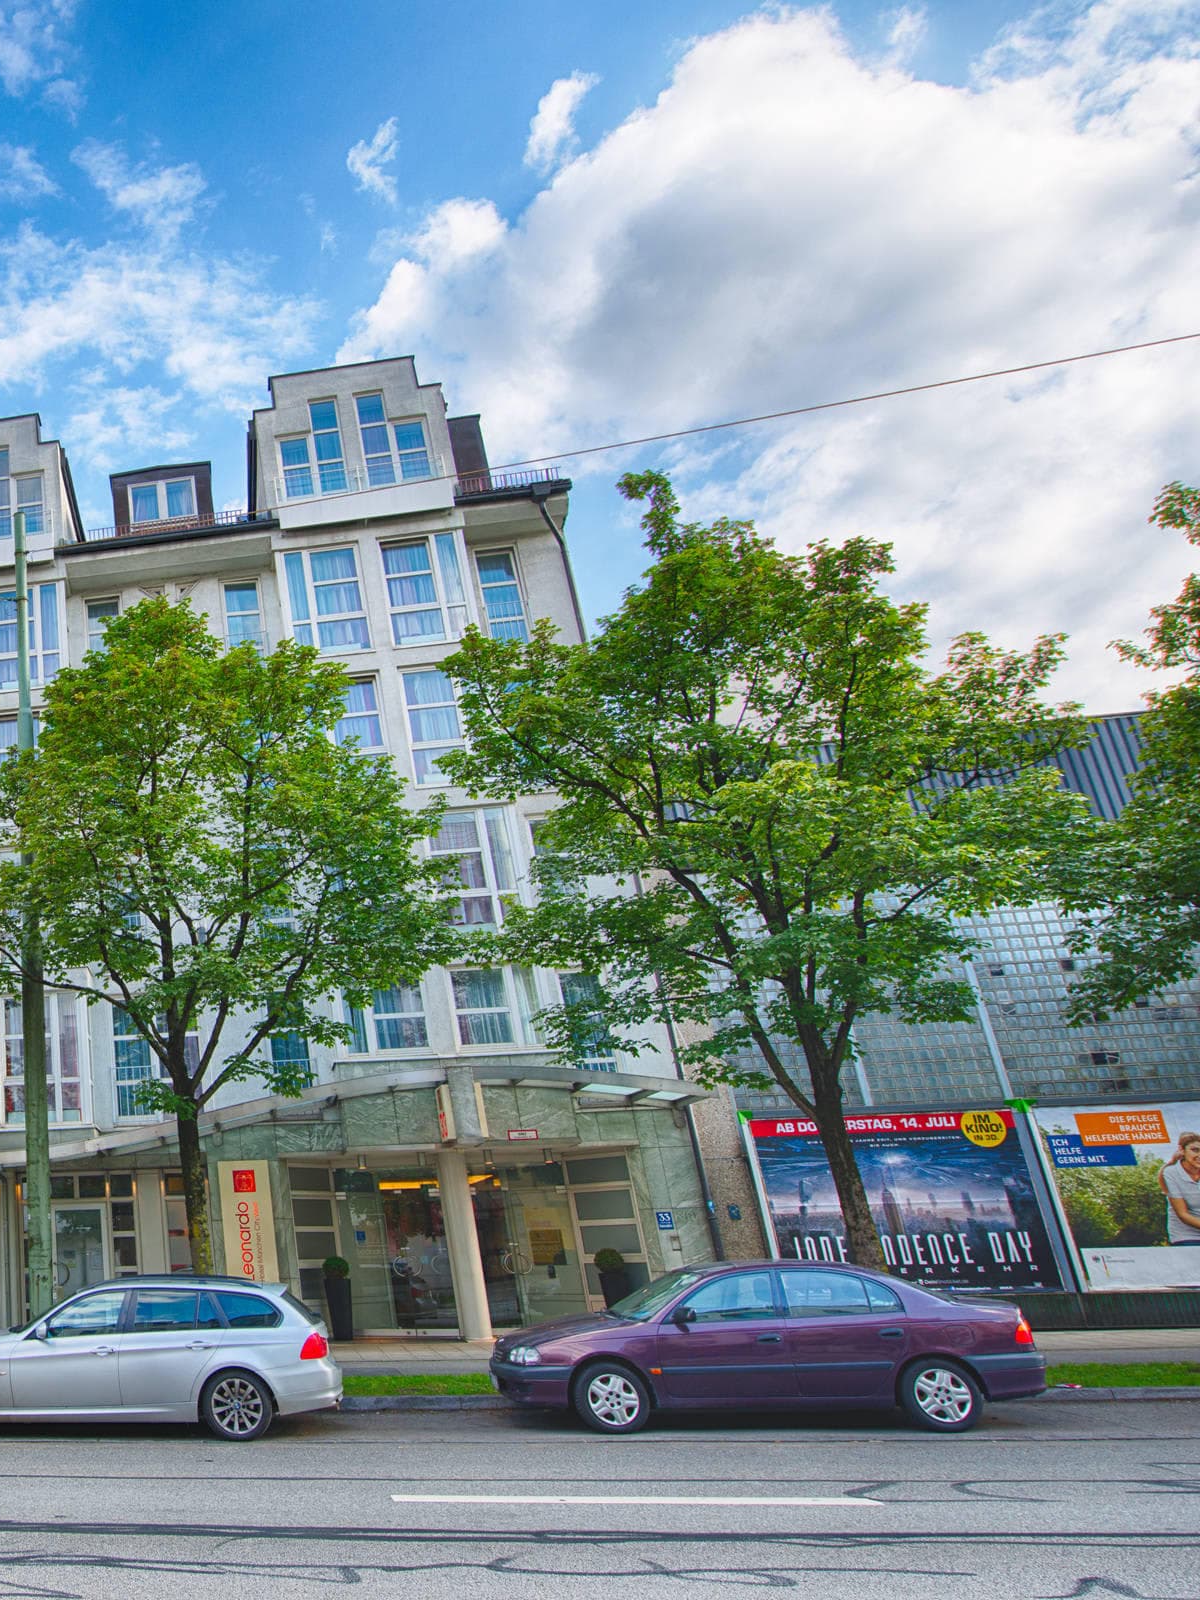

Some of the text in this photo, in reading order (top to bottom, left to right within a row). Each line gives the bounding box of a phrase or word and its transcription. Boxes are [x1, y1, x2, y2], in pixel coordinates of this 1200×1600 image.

[776, 1115, 956, 1133] AB DORSTAG, 14. JULI
[972, 1114, 990, 1124] IM
[1109, 1114, 1159, 1124] DIE PFLEGE
[965, 1122, 1004, 1134] KINO!
[1119, 1123, 1161, 1132] BRAUCHT
[1085, 1131, 1166, 1142] HELFENDE HÄNDE.
[1051, 1138, 1069, 1146] ICH
[1054, 1147, 1082, 1155] HELFE
[1057, 1155, 1108, 1164] GERNE MIT.
[658, 1213, 671, 1222] 33
[793, 1231, 1033, 1265] INDENDENCE DAY
